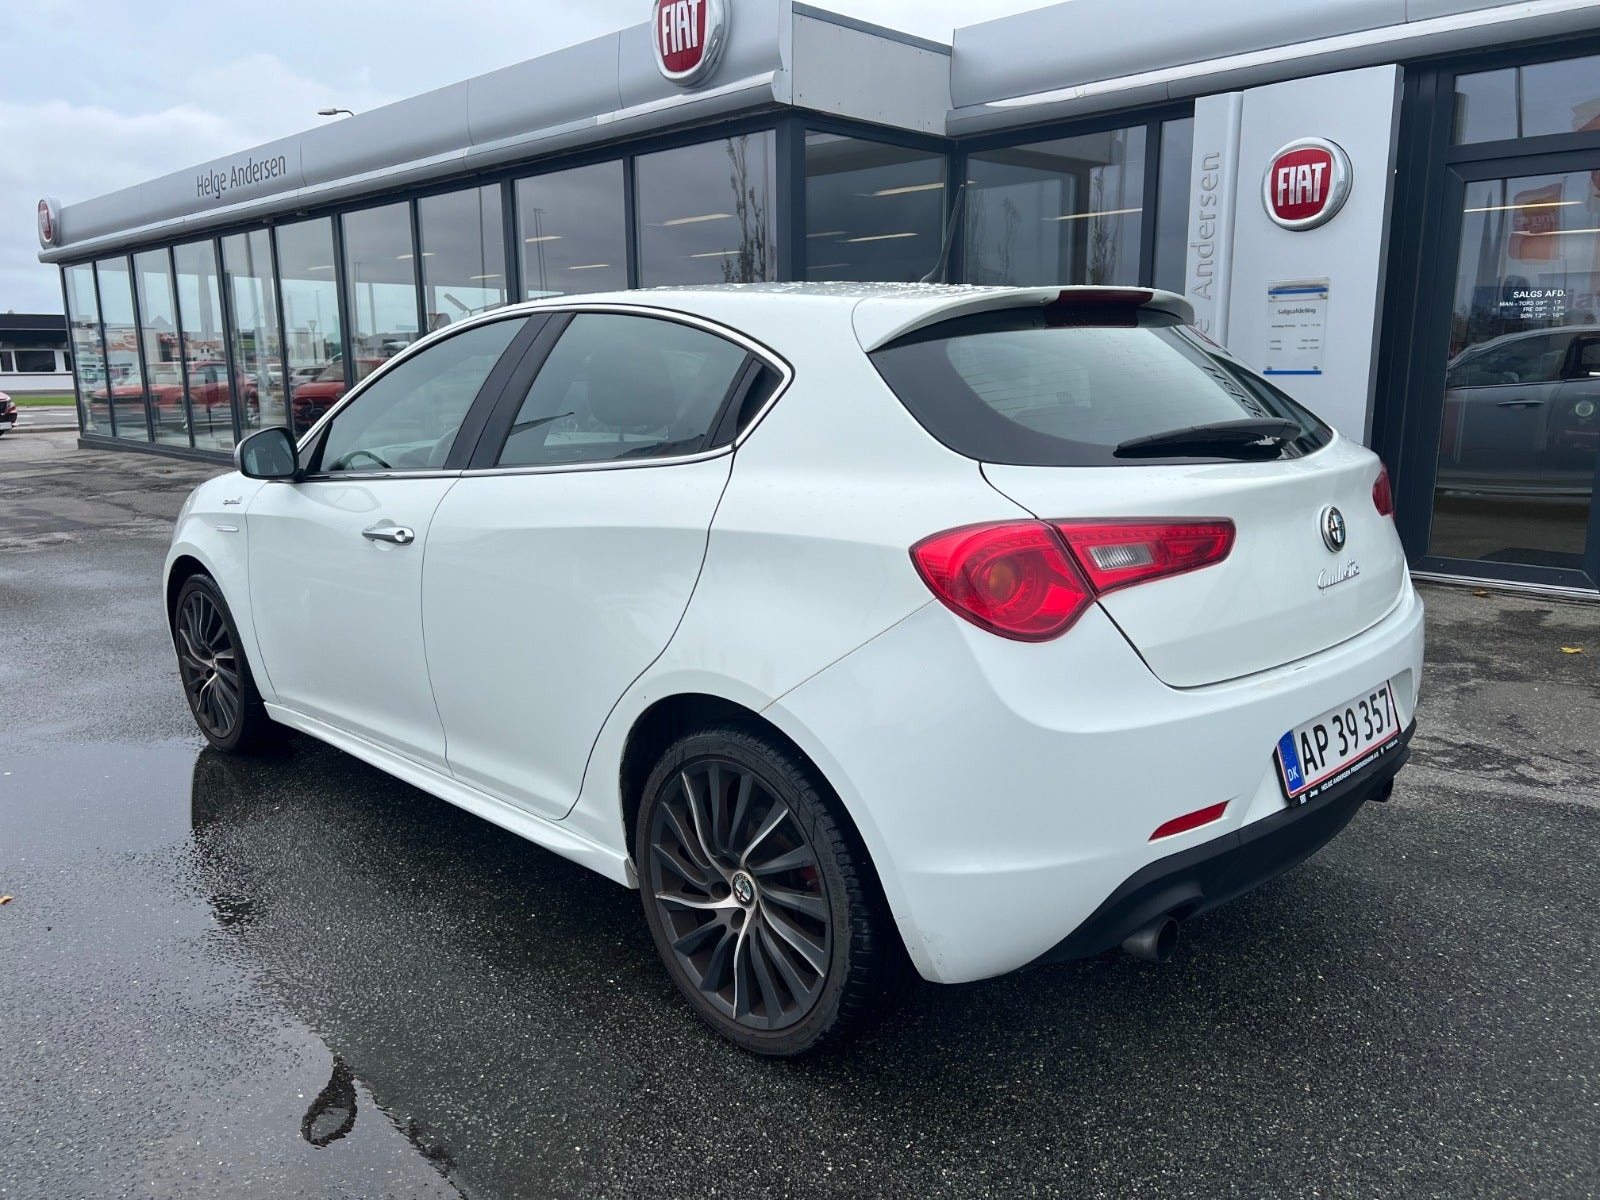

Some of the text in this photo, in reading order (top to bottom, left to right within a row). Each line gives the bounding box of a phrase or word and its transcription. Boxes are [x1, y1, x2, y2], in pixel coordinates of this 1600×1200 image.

[662, 0, 702, 56] FIAT
[196, 155, 286, 200] Helge Andersen
[1277, 162, 1328, 207] FIAT
[1190, 151, 1220, 301] Andersen
[1513, 289, 1567, 299] SALGS AFD.
[1300, 687, 1391, 776] AP 39 357
[1287, 765, 1300, 782] DK
